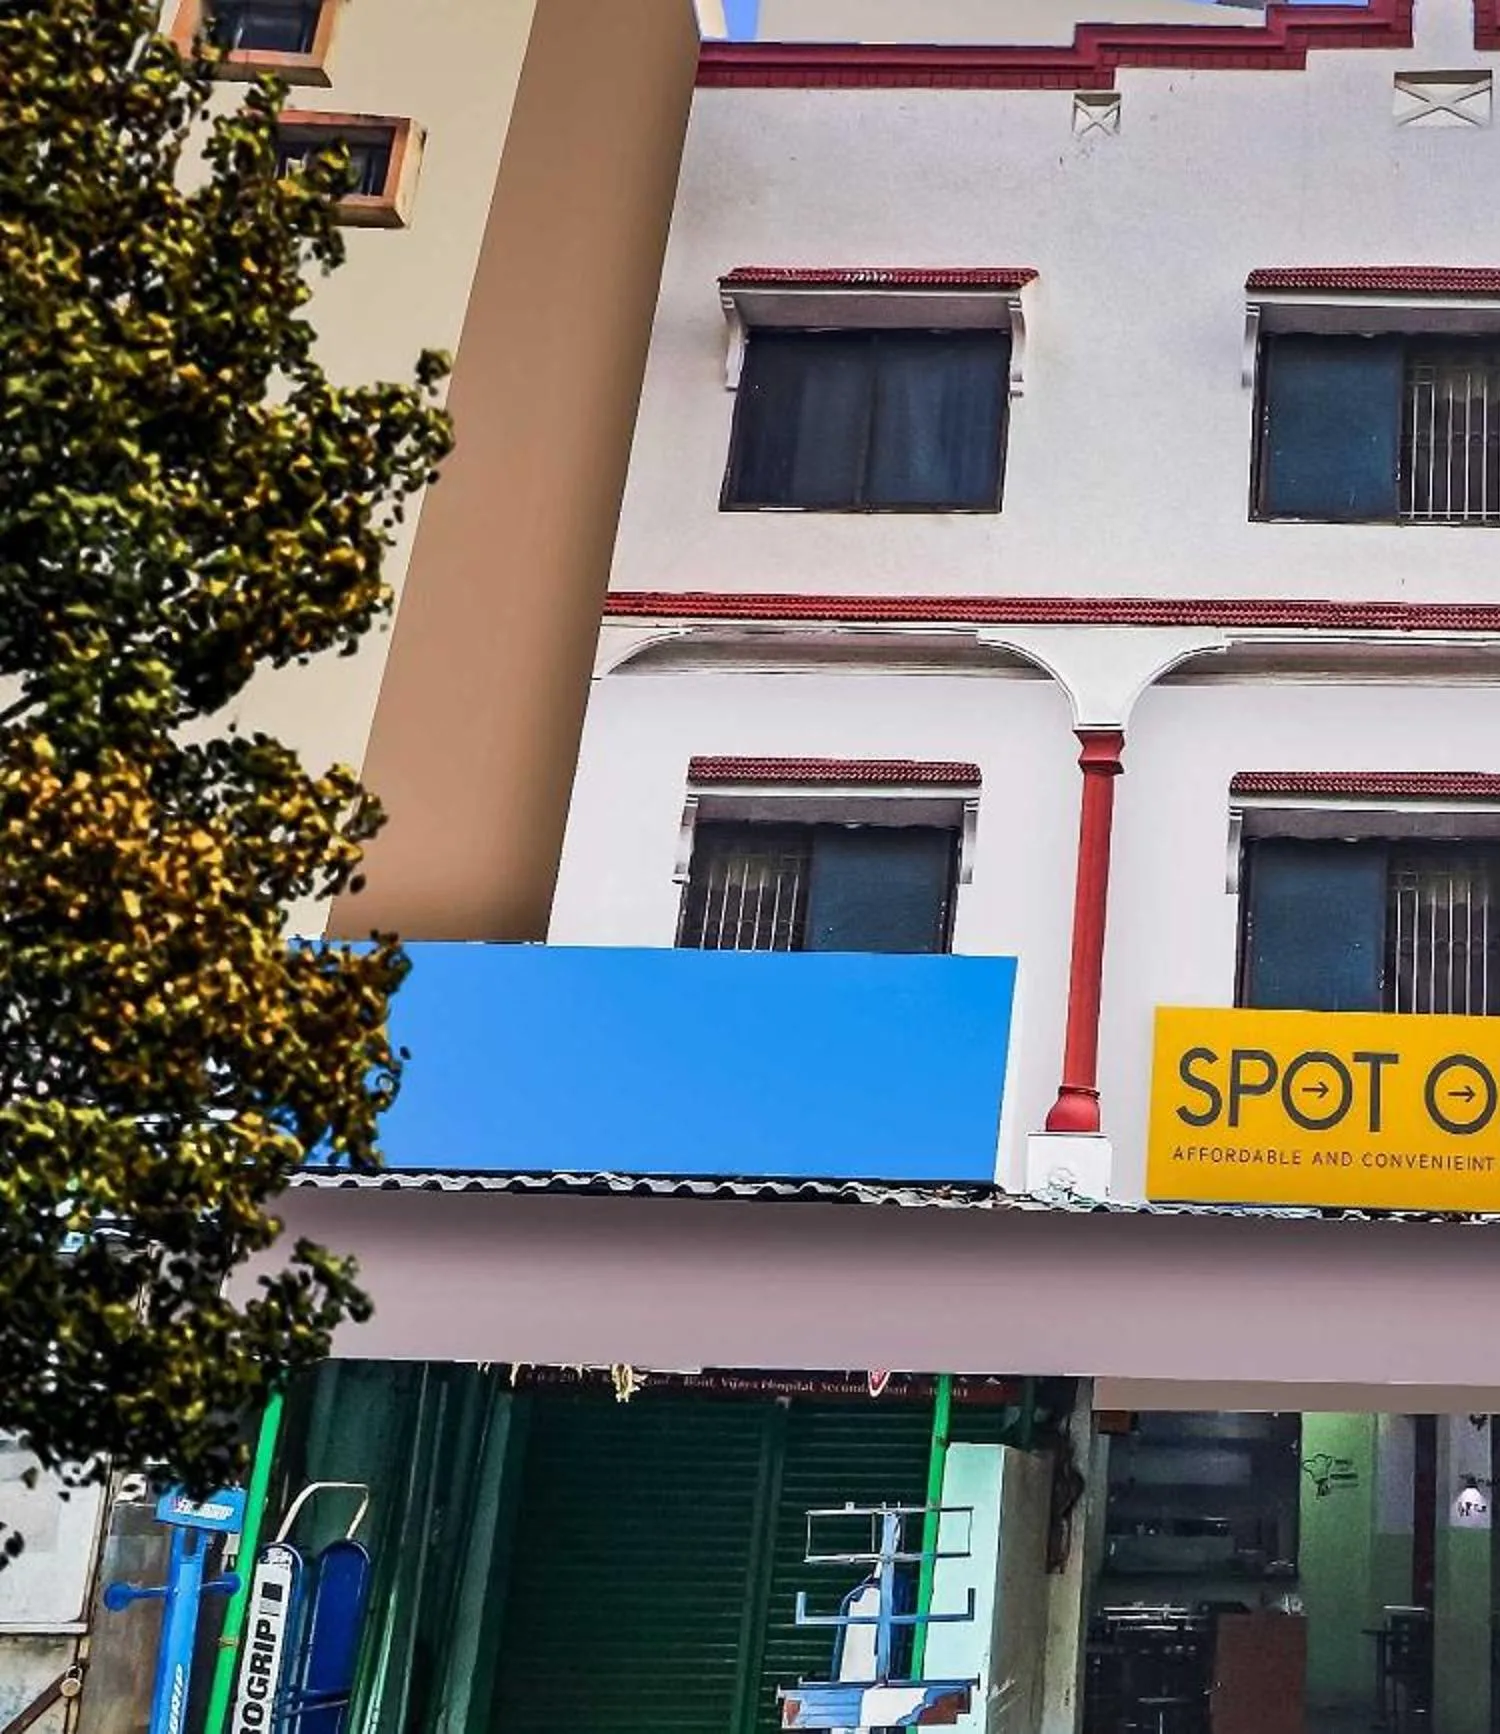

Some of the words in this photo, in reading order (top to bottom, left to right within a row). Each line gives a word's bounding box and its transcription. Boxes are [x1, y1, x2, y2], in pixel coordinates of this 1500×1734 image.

[1175, 1046, 1400, 1133] SPOT
[1172, 1145, 1302, 1166] AFFORDABLE
[1311, 1151, 1353, 1168] AND
